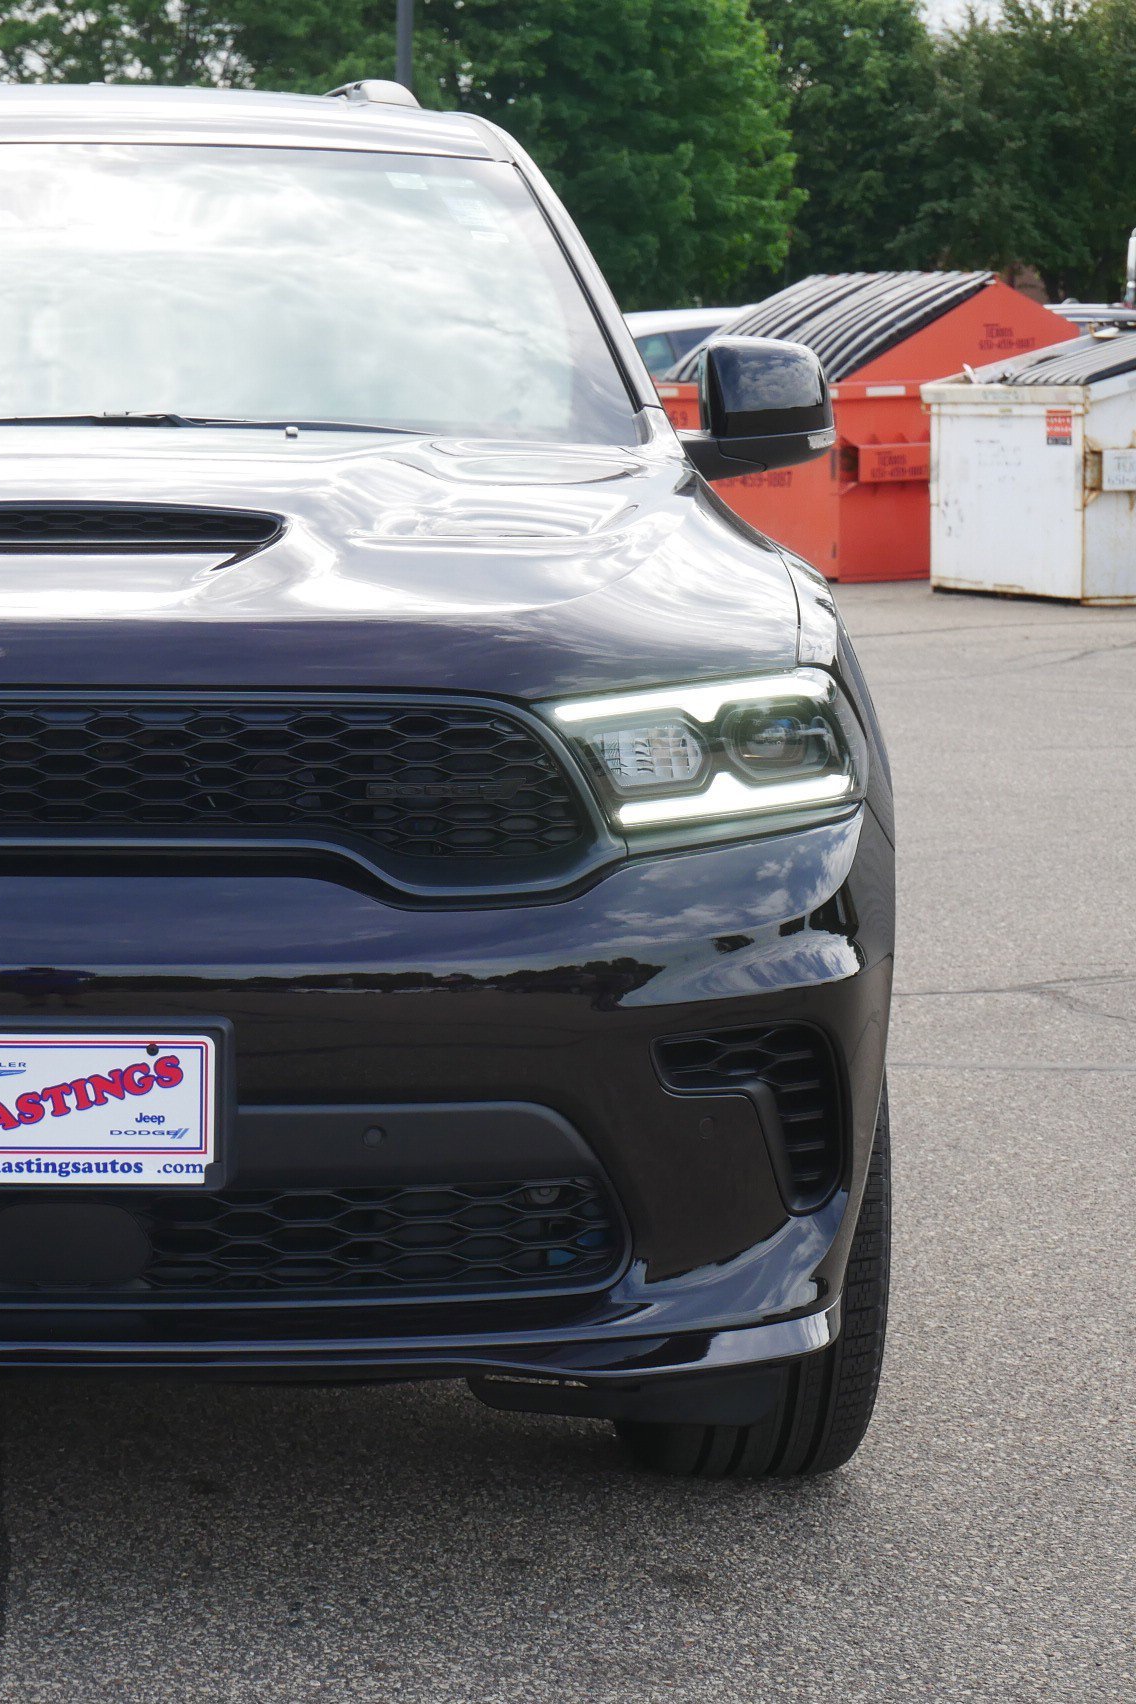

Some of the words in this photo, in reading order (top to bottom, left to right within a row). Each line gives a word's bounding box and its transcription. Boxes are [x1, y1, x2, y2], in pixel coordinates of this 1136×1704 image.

[367, 783, 504, 798] DODGE
[134, 1112, 166, 1125] Jeep
[109, 1129, 179, 1137] DODGE
[156, 1162, 204, 1174] .com
